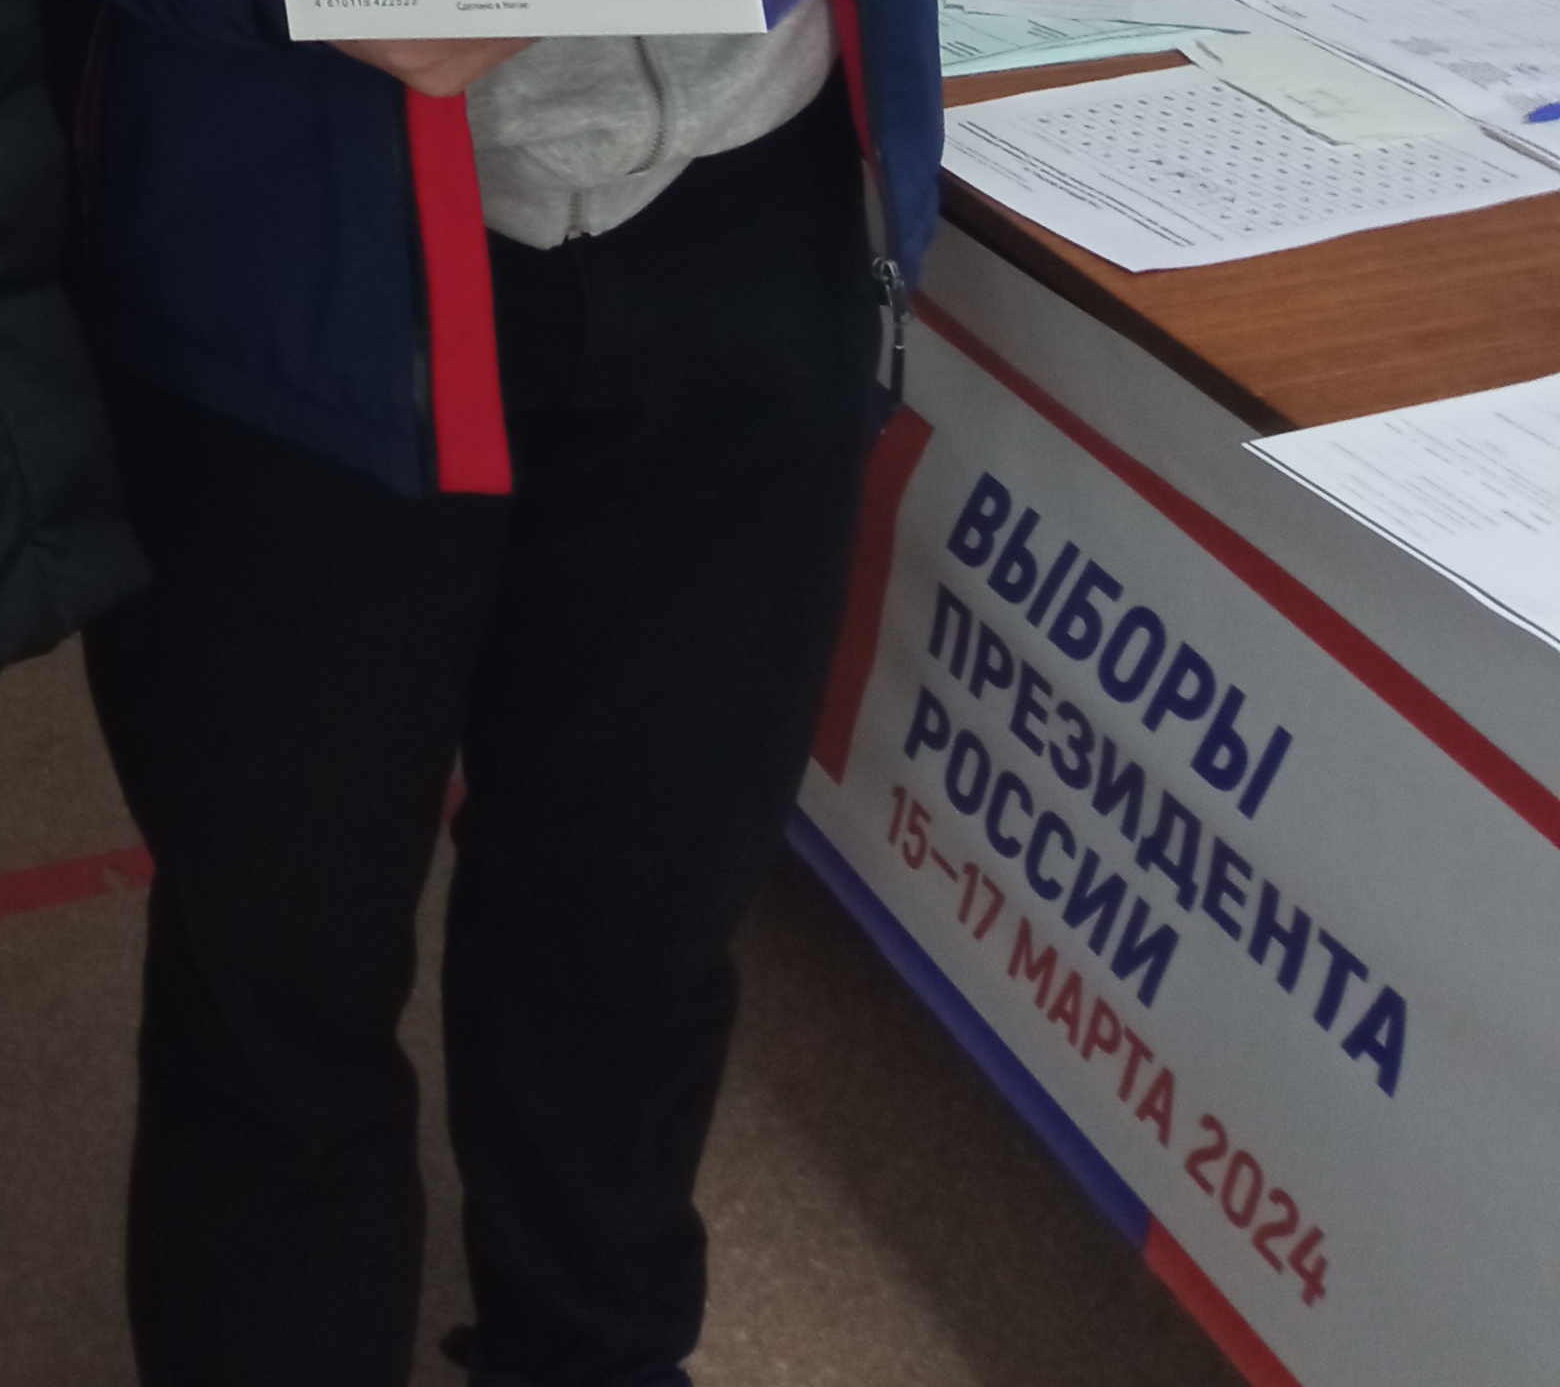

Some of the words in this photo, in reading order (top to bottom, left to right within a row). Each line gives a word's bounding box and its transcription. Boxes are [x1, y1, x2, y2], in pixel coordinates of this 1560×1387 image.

[945, 471, 1294, 819] ВЫБОРЫ
[902, 686, 1181, 1009] РОССИИ
[928, 583, 1410, 1099] ПРЕЗИДЕНТА
[1007, 917, 1178, 1149] МАРТА
[1184, 1114, 1329, 1308] 2024
